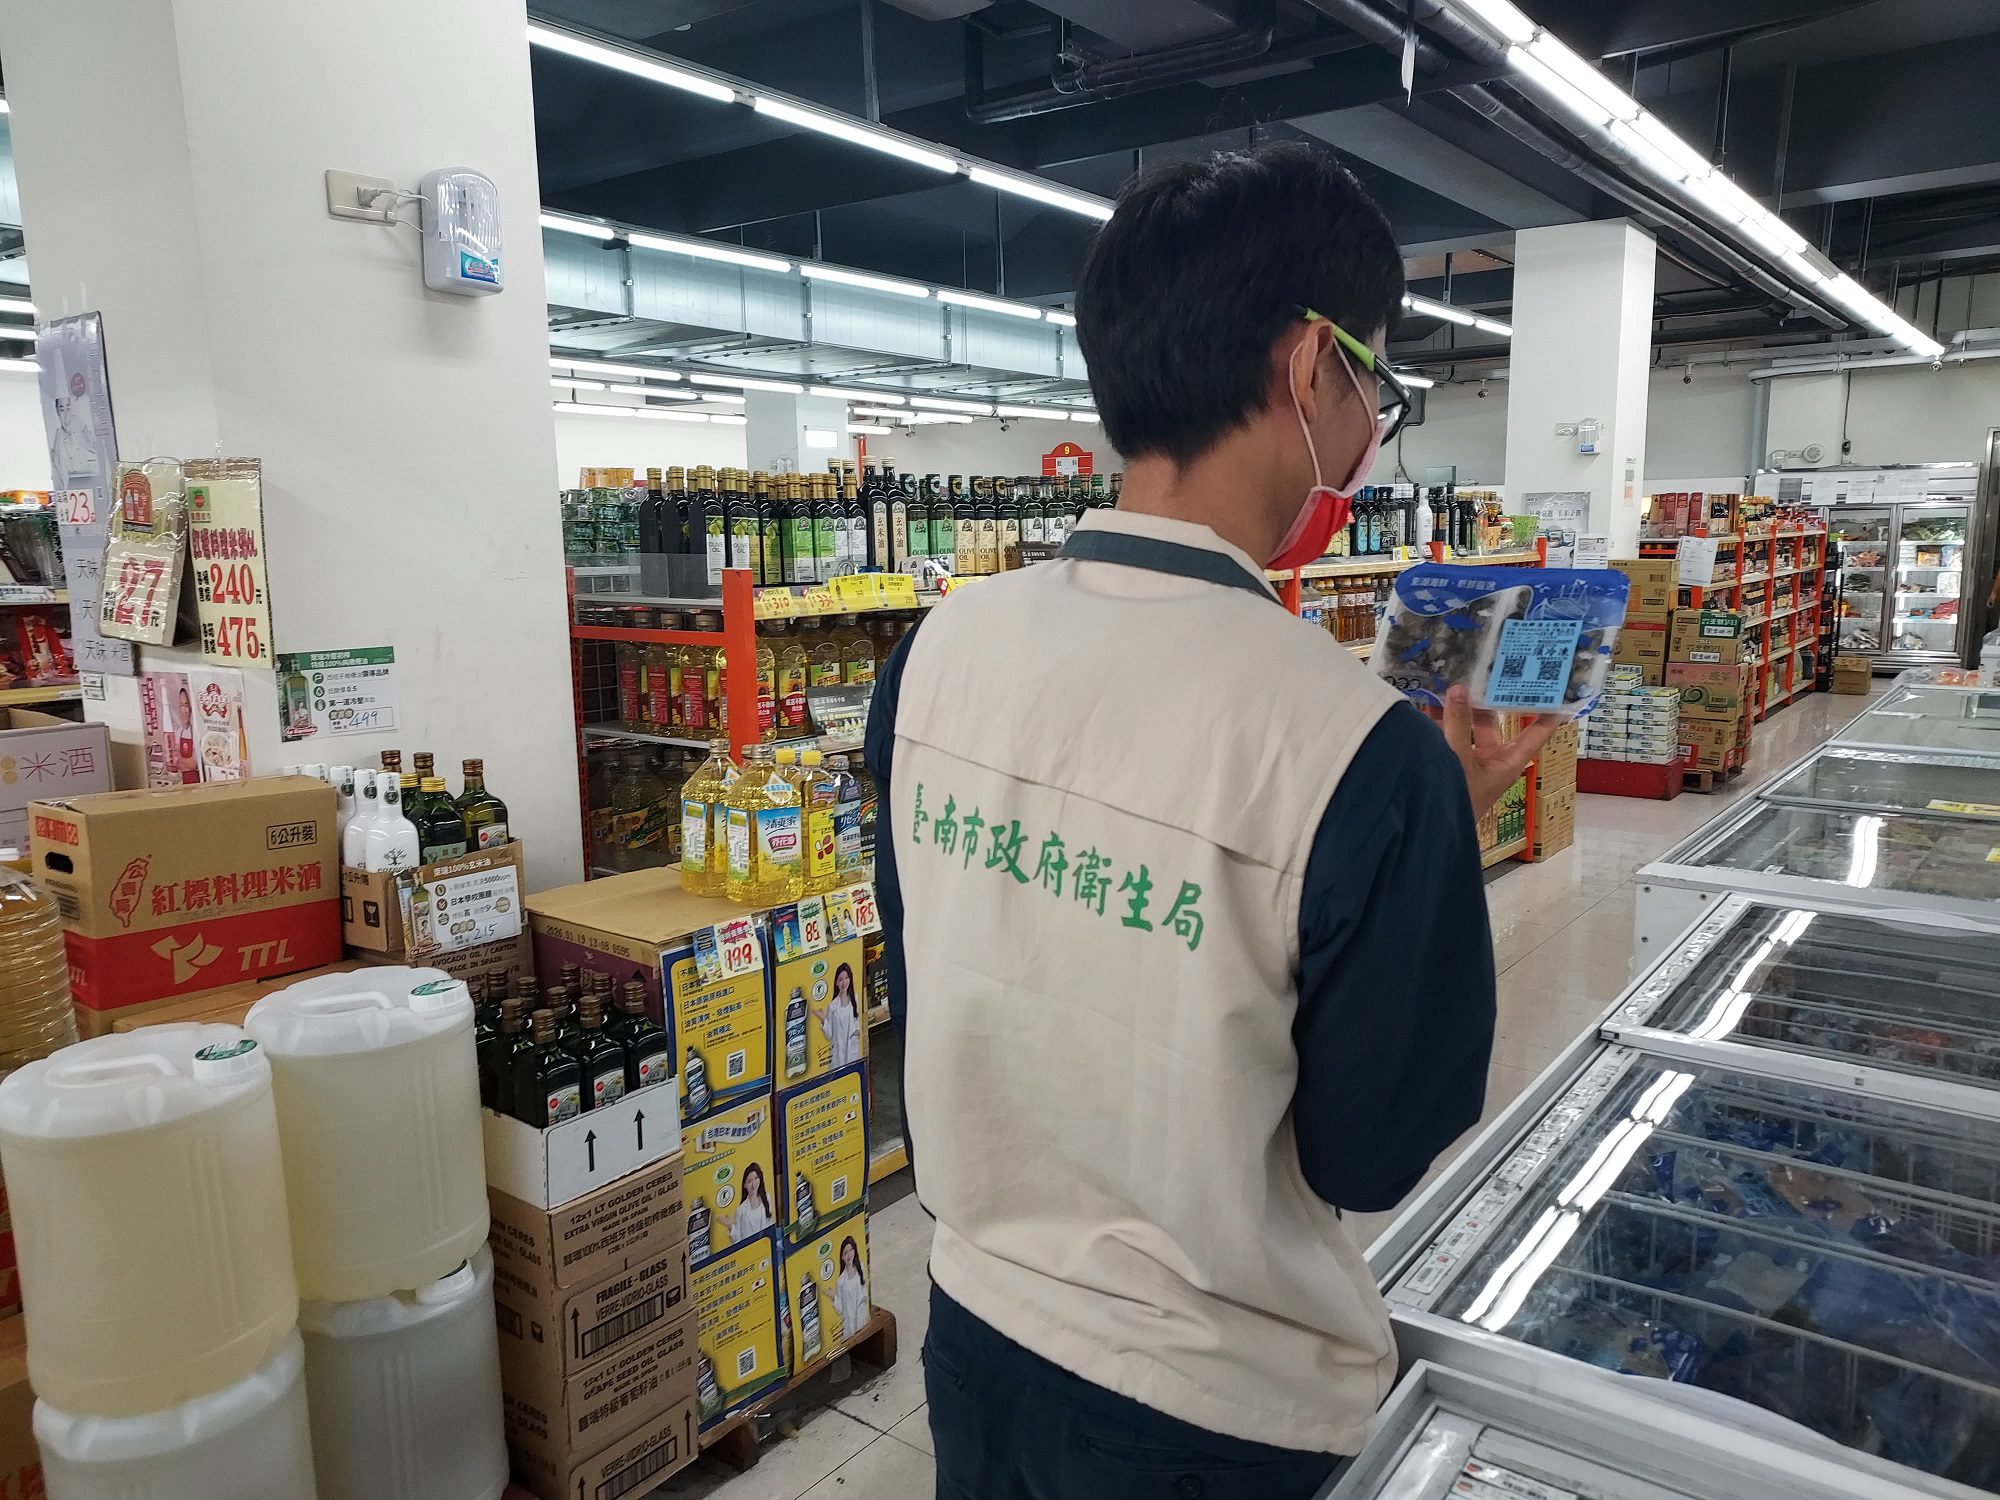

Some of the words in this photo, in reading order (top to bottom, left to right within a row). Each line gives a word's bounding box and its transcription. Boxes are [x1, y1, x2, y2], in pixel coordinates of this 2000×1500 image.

[1063, 445, 1071, 455] 9
[69, 492, 90, 523] 23
[877, 516, 885, 549] 玄米油
[896, 516, 904, 548] 玄米油
[959, 547, 976, 555] OLIVE
[115, 560, 165, 626] 27
[210, 563, 254, 605] 240
[217, 616, 259, 659] 475
[349, 711, 378, 728] 499
[20, 746, 95, 783] 米酒
[270, 823, 315, 848] 6公升裝
[152, 861, 322, 916] 紅標料理米酒
[474, 922, 498, 940] 215
[856, 902, 874, 927] 185
[806, 921, 821, 943] 85
[237, 939, 296, 972] TTL
[431, 953, 467, 967] AVOCADO
[490, 943, 518, 955] CARTON
[727, 943, 753, 972] 199
[564, 1224, 590, 1241] EXTRA
[592, 1211, 618, 1227] VIRGIN
[618, 1201, 641, 1218] OLIVE
[641, 1194, 653, 1207] OIL
[658, 1180, 679, 1196] GLASS
[570, 1209, 593, 1225] 12x1
[594, 1203, 605, 1215] LT
[607, 1185, 644, 1208] GOLDEN
[646, 1172, 673, 1191] CERES
[596, 1275, 633, 1305] FRAGILE
[638, 1259, 667, 1281] GLASS
[606, 1363, 618, 1376] LT
[619, 1343, 655, 1366] GOLDEN
[656, 1328, 684, 1348] CERES
[584, 1382, 614, 1401] GRAPE
[616, 1369, 640, 1384] SEED
[641, 1359, 655, 1373] OIL
[657, 1339, 685, 1360] GLASS
